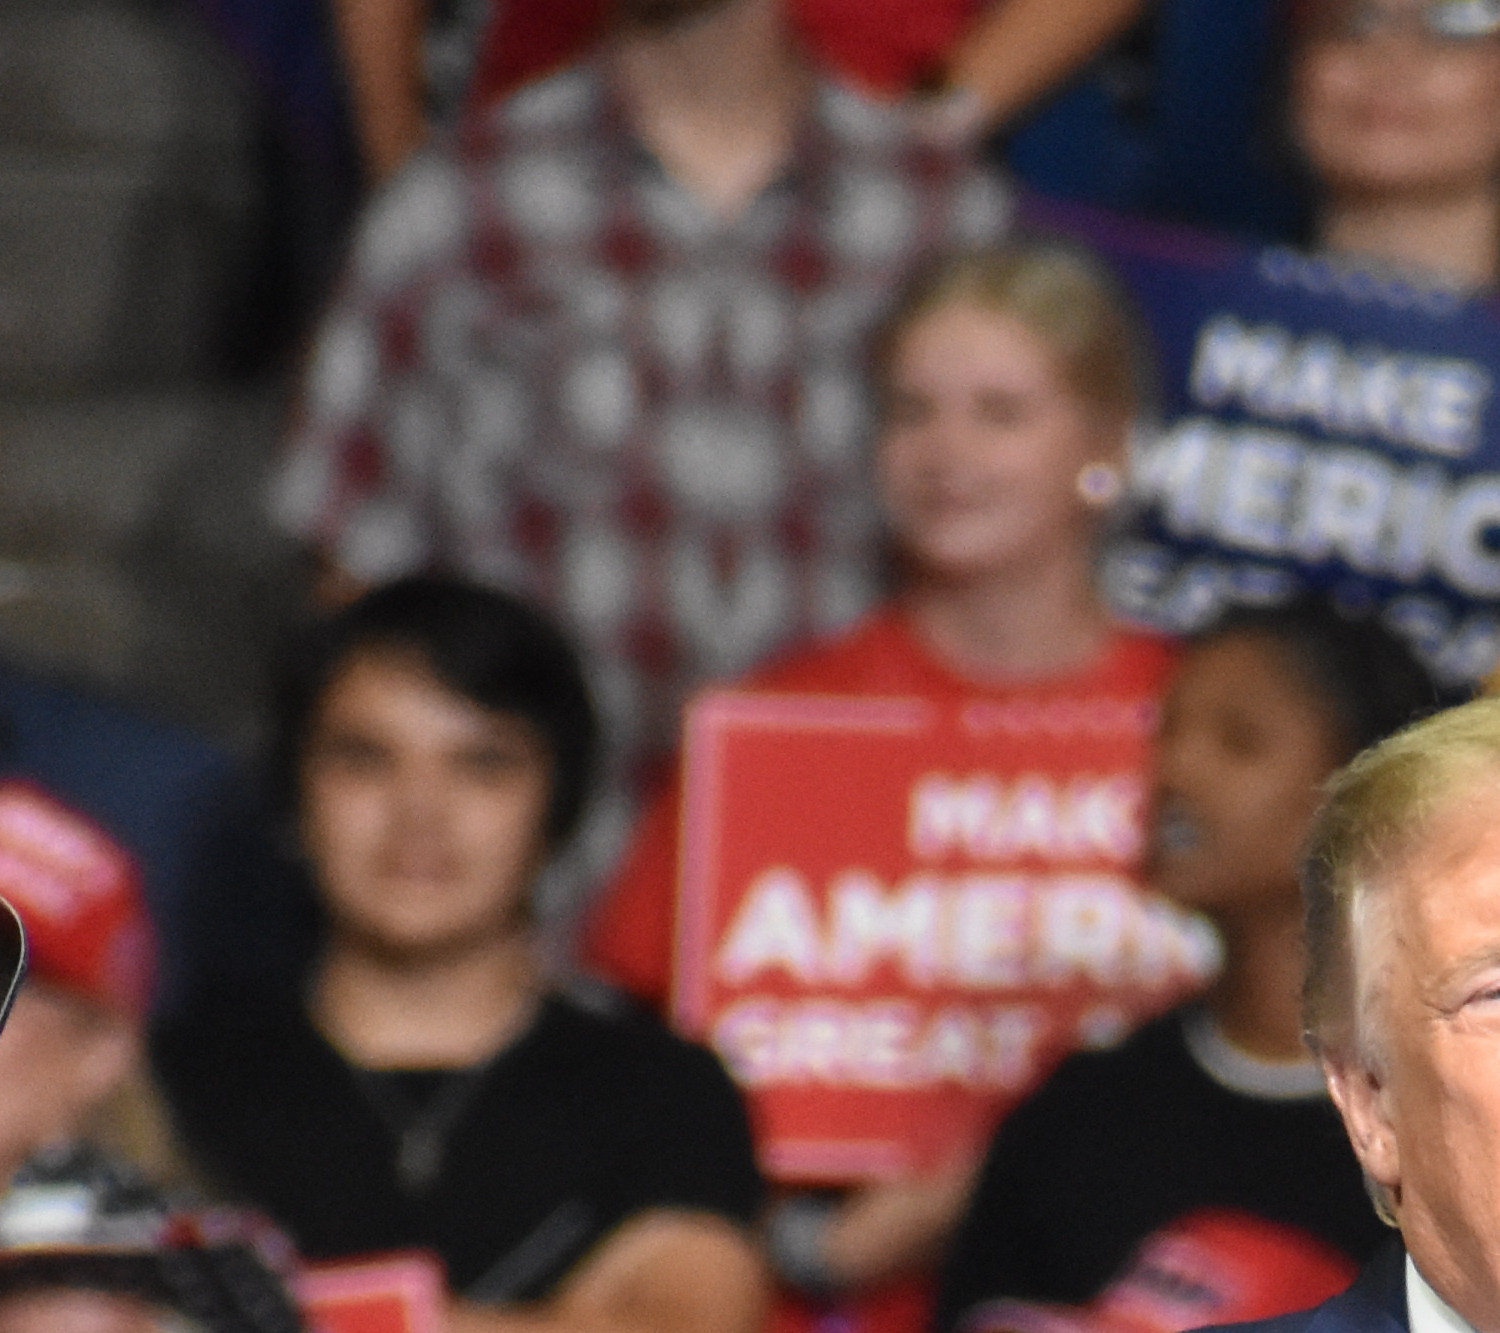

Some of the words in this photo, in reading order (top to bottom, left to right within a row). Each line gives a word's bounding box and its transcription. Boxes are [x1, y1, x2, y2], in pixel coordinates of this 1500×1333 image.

[1190, 315, 1492, 459] MAKE
[907, 771, 1147, 862] MAK
[715, 866, 1224, 990] AMER
